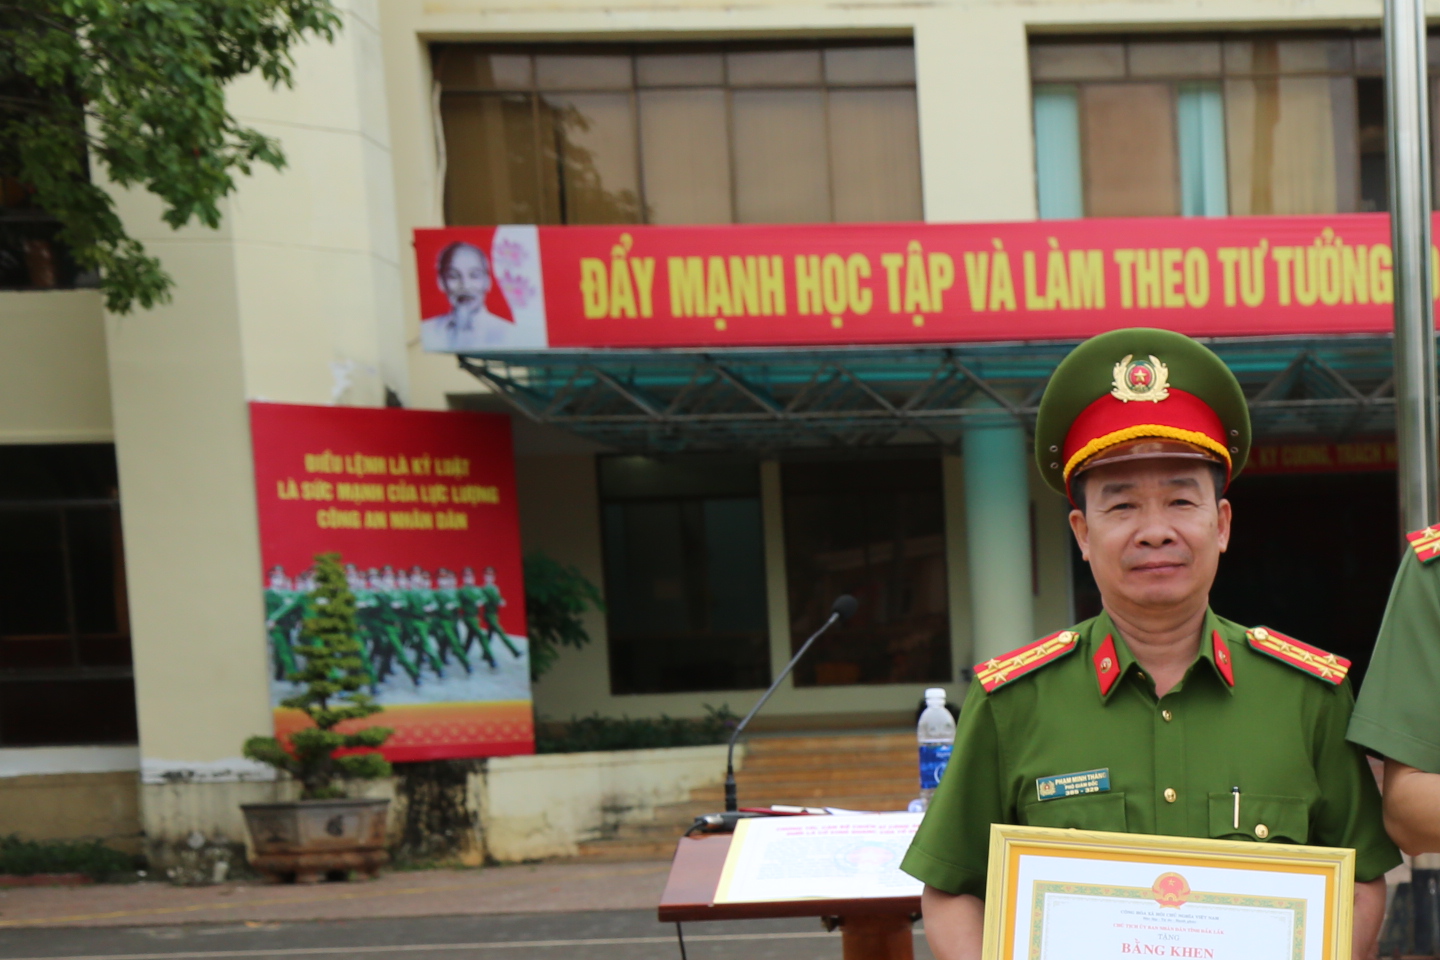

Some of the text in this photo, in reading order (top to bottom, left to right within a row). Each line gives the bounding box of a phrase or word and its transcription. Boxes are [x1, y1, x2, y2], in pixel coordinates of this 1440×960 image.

[580, 233, 655, 319] ĐẨY
[667, 255, 786, 330] MẠNH
[795, 252, 872, 329] HỌC
[881, 240, 955, 326] TẬP
[964, 237, 1016, 312] VÀ
[1023, 237, 1106, 310] LÀM
[1114, 246, 1210, 309] THEO
[1217, 238, 1269, 307] TƯ
[1272, 227, 1393, 307] TƯỞNG
[345, 452, 387, 478] LỆNH
[389, 454, 410, 475] LÀ
[434, 454, 470, 480] LUẬT
[277, 477, 499, 507] LÀ SỨC MẠNH CỦA LỰC LƯỢNG
[316, 506, 468, 530] CÔNG AN NHÂN DÂN
[1121, 938, 1214, 959] BẰNG KHEN
